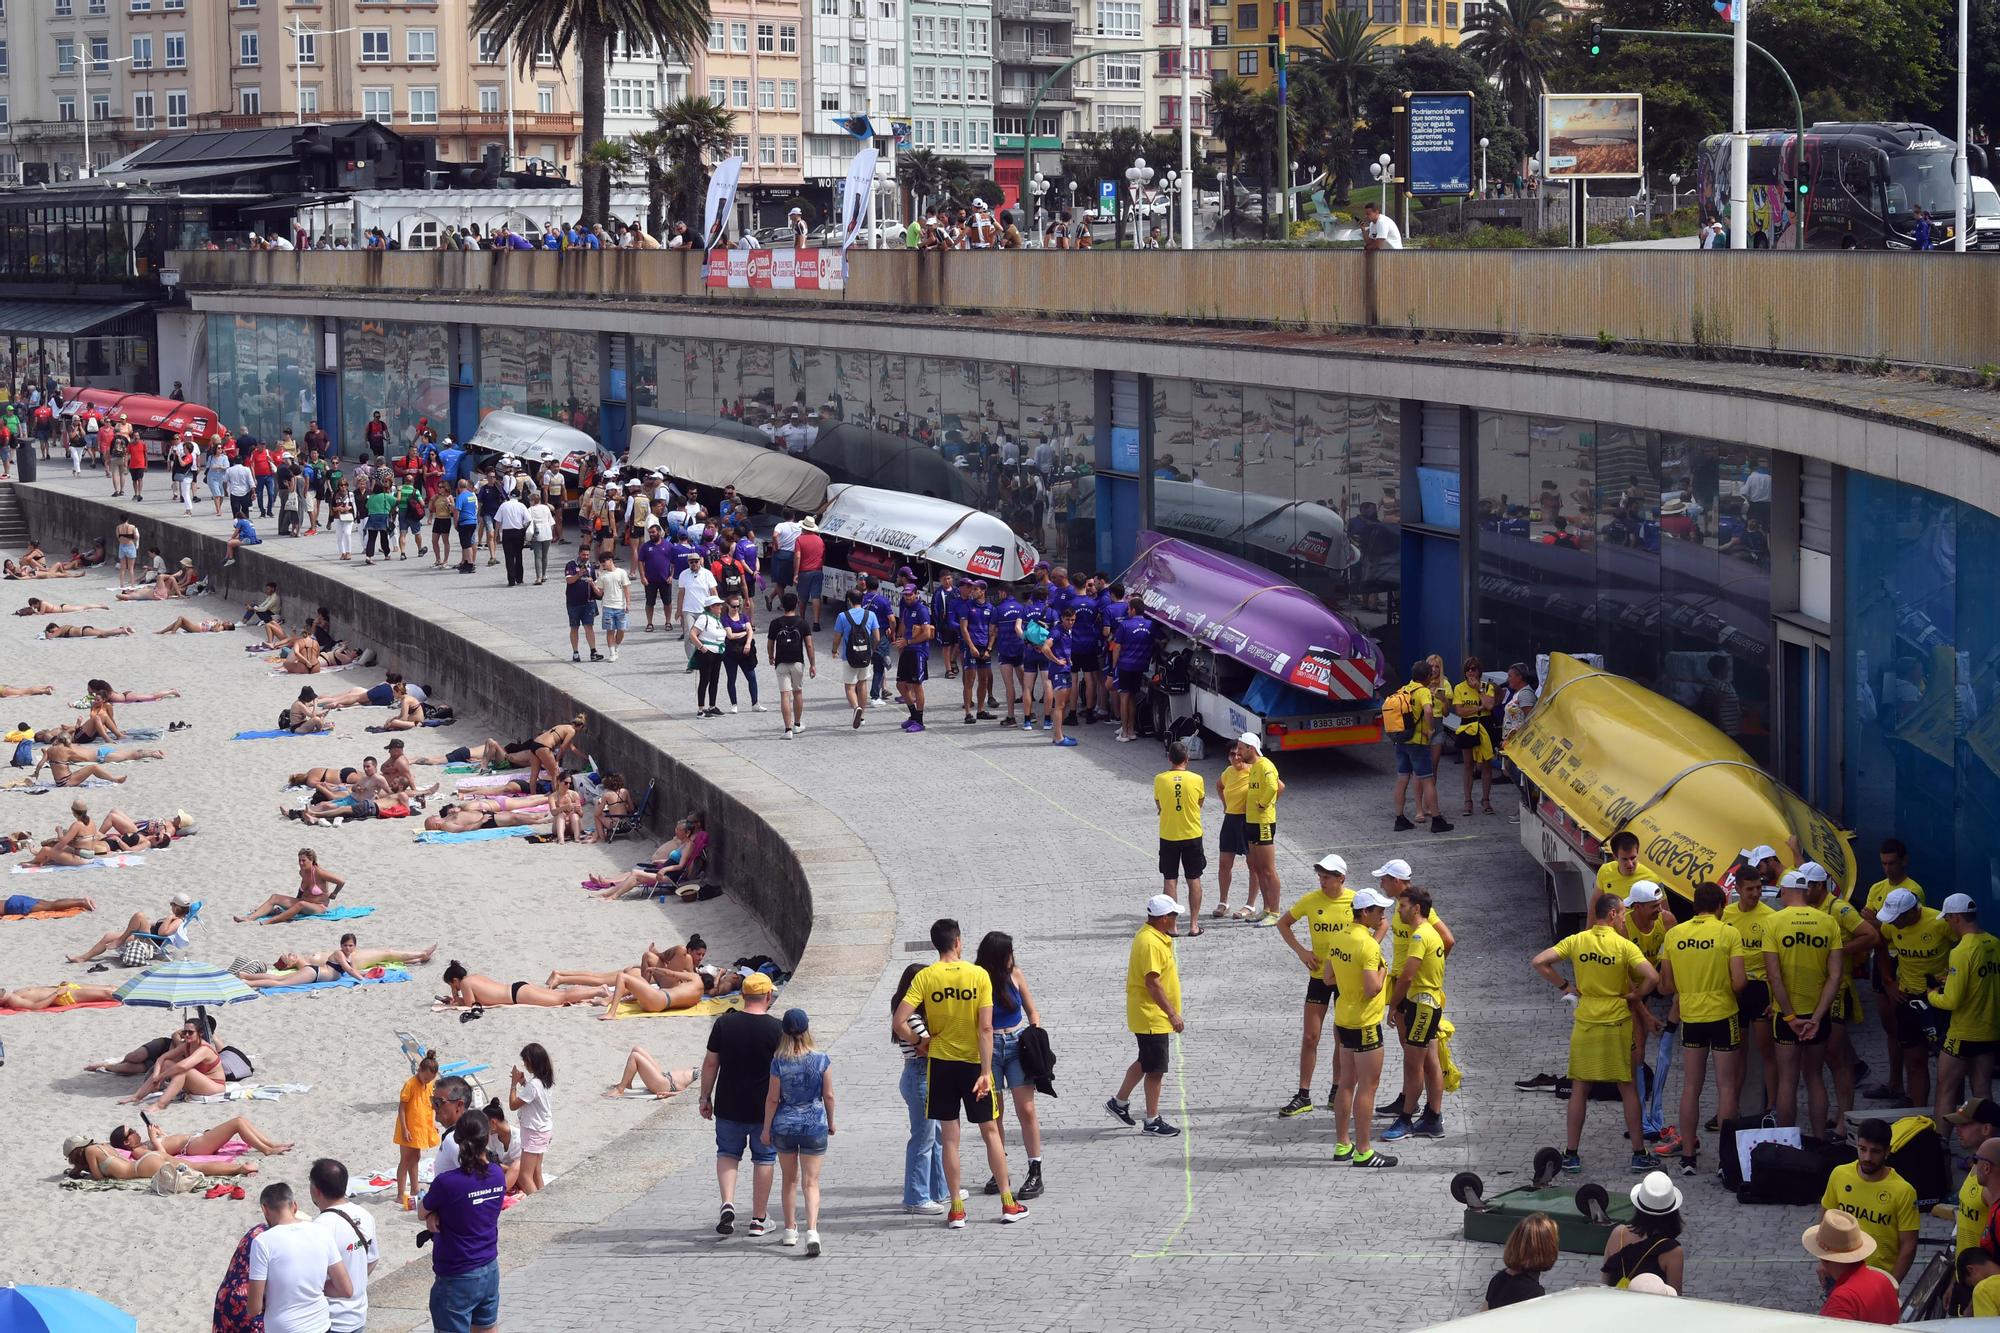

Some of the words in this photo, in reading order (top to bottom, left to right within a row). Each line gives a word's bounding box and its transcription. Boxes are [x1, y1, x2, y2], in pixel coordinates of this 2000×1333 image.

[1103, 183, 1113, 195] P
[1313, 718, 1333, 728] 8383
[1174, 783, 1182, 812] ORIO
[1644, 834, 1715, 890] SAGARDI
[1677, 938, 1715, 951] ORIO!
[1782, 931, 1828, 949] ORIO!
[1579, 952, 1616, 966] ORIO!
[931, 987, 978, 1004] ORIO!
[1412, 1011, 1429, 1041] ORIALKI
